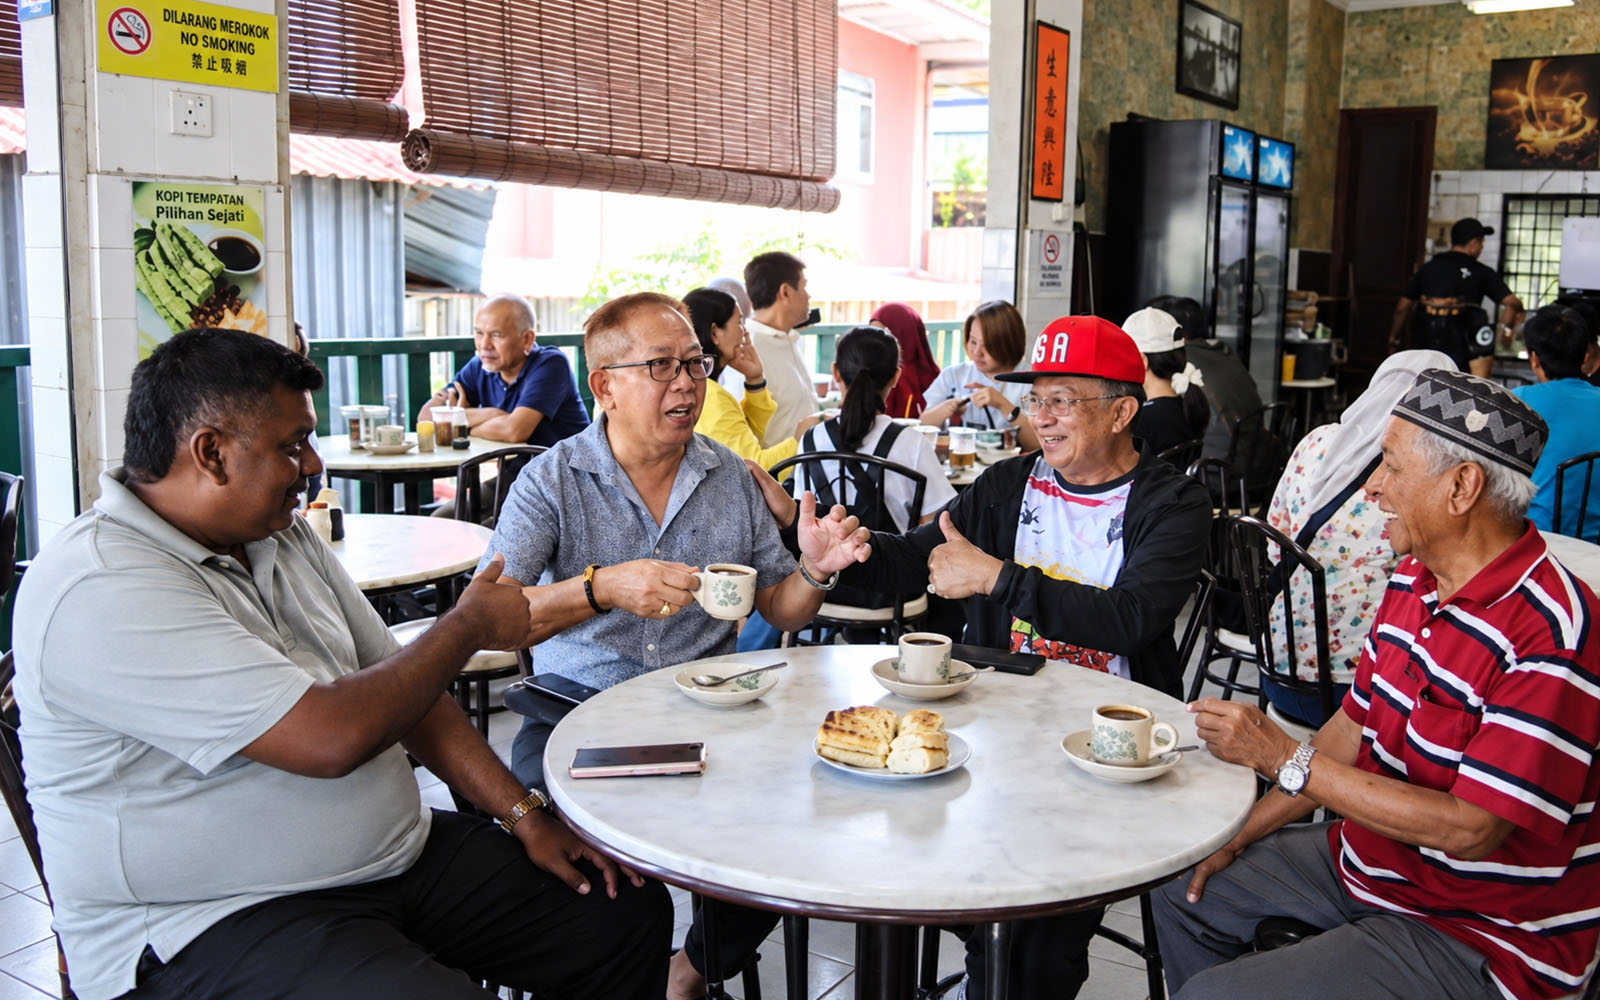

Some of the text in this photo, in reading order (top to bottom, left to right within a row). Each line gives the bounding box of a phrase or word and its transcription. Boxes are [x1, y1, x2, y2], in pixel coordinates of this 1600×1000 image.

[163, 8, 270, 40] DILARANG MEROKOK
[180, 31, 256, 55] NO SMOKING
[156, 190, 244, 206] KOPI TEMPATAN
[156, 206, 245, 224] Pilihan Sejati
